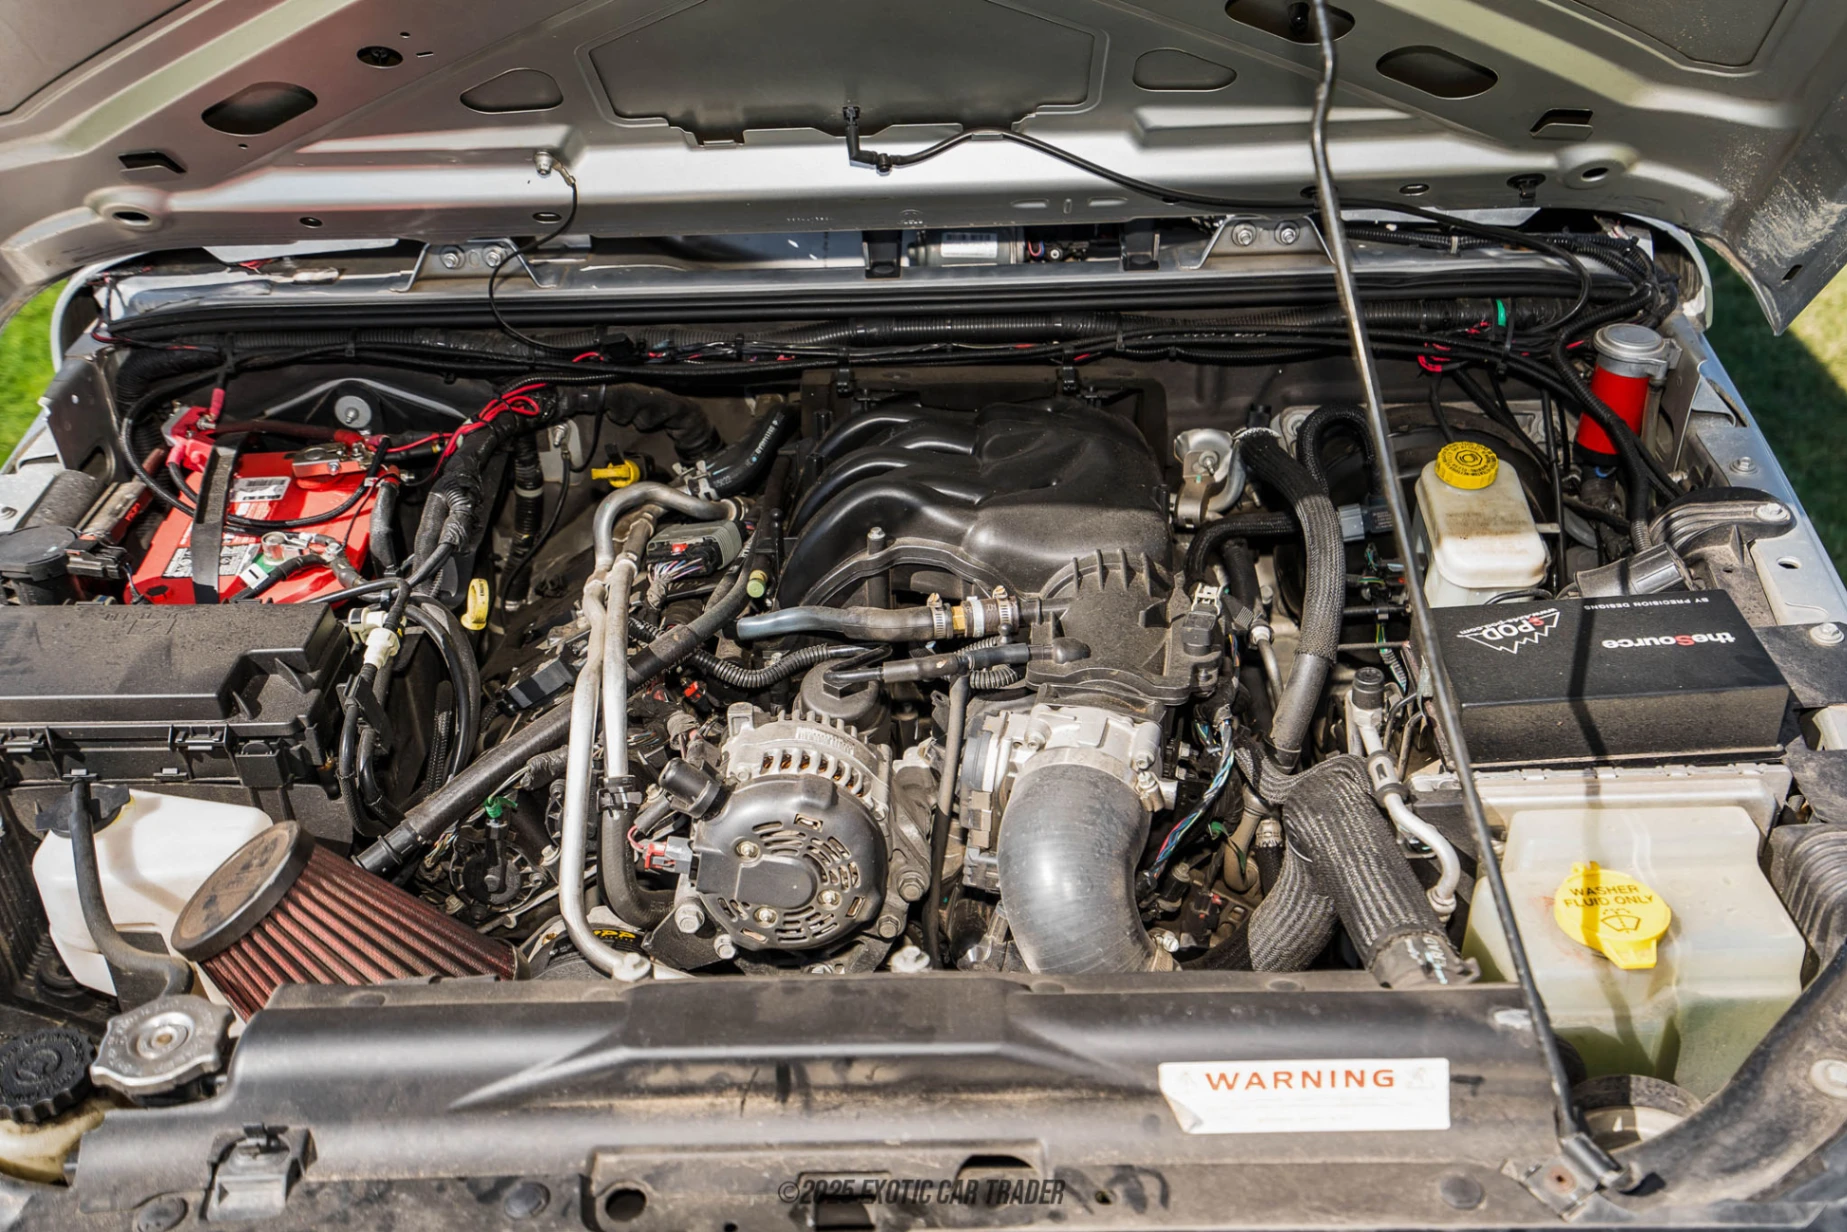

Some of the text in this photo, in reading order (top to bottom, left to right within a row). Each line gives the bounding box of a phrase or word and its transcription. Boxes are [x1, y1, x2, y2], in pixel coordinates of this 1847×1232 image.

[1583, 601, 1630, 610] DESIGNS
[1632, 598, 1692, 607] PRECISION
[1601, 632, 1736, 649] theSource
[1569, 884, 1640, 897] WASHER
[1563, 894, 1654, 908] FLUID ONLY
[1205, 1069, 1396, 1091] WARNING
